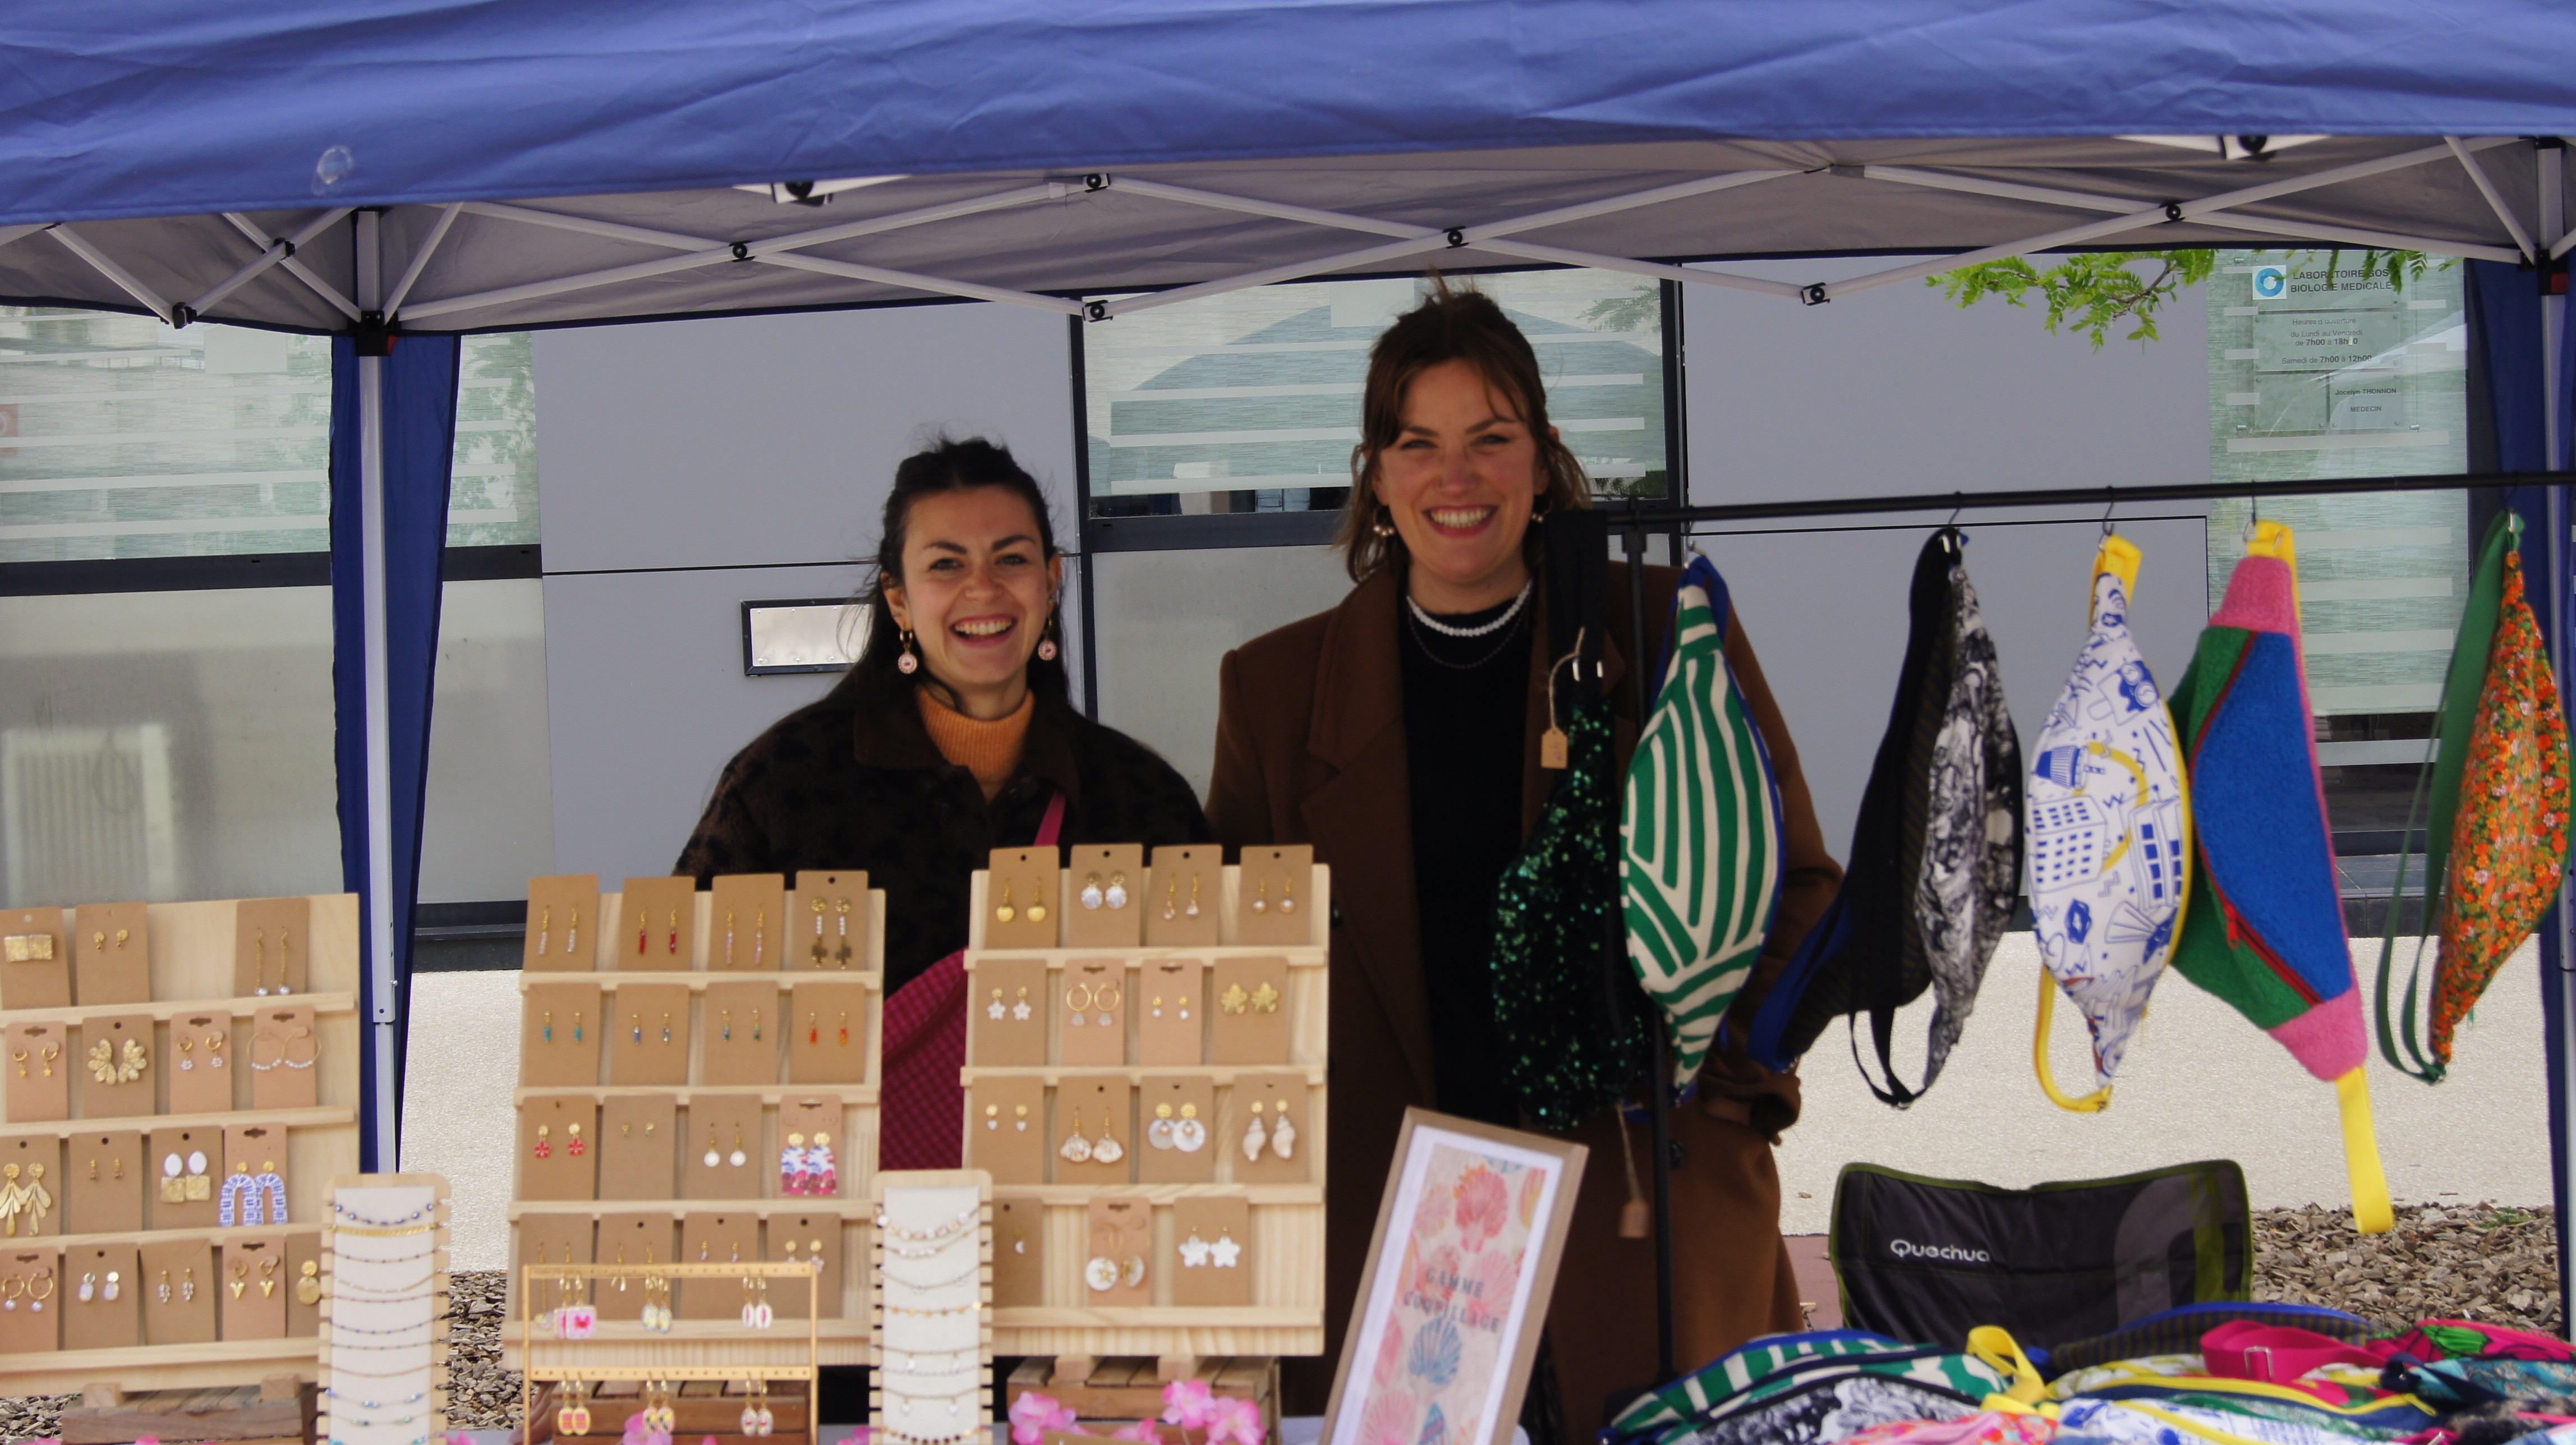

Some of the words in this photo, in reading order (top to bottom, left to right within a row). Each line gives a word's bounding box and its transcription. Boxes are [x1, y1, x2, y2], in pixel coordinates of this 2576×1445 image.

[2293, 269, 2363, 280] LABORTOIRE
[2341, 282, 2392, 290] MEDICALE
[1890, 1239, 1990, 1262] Quechua
